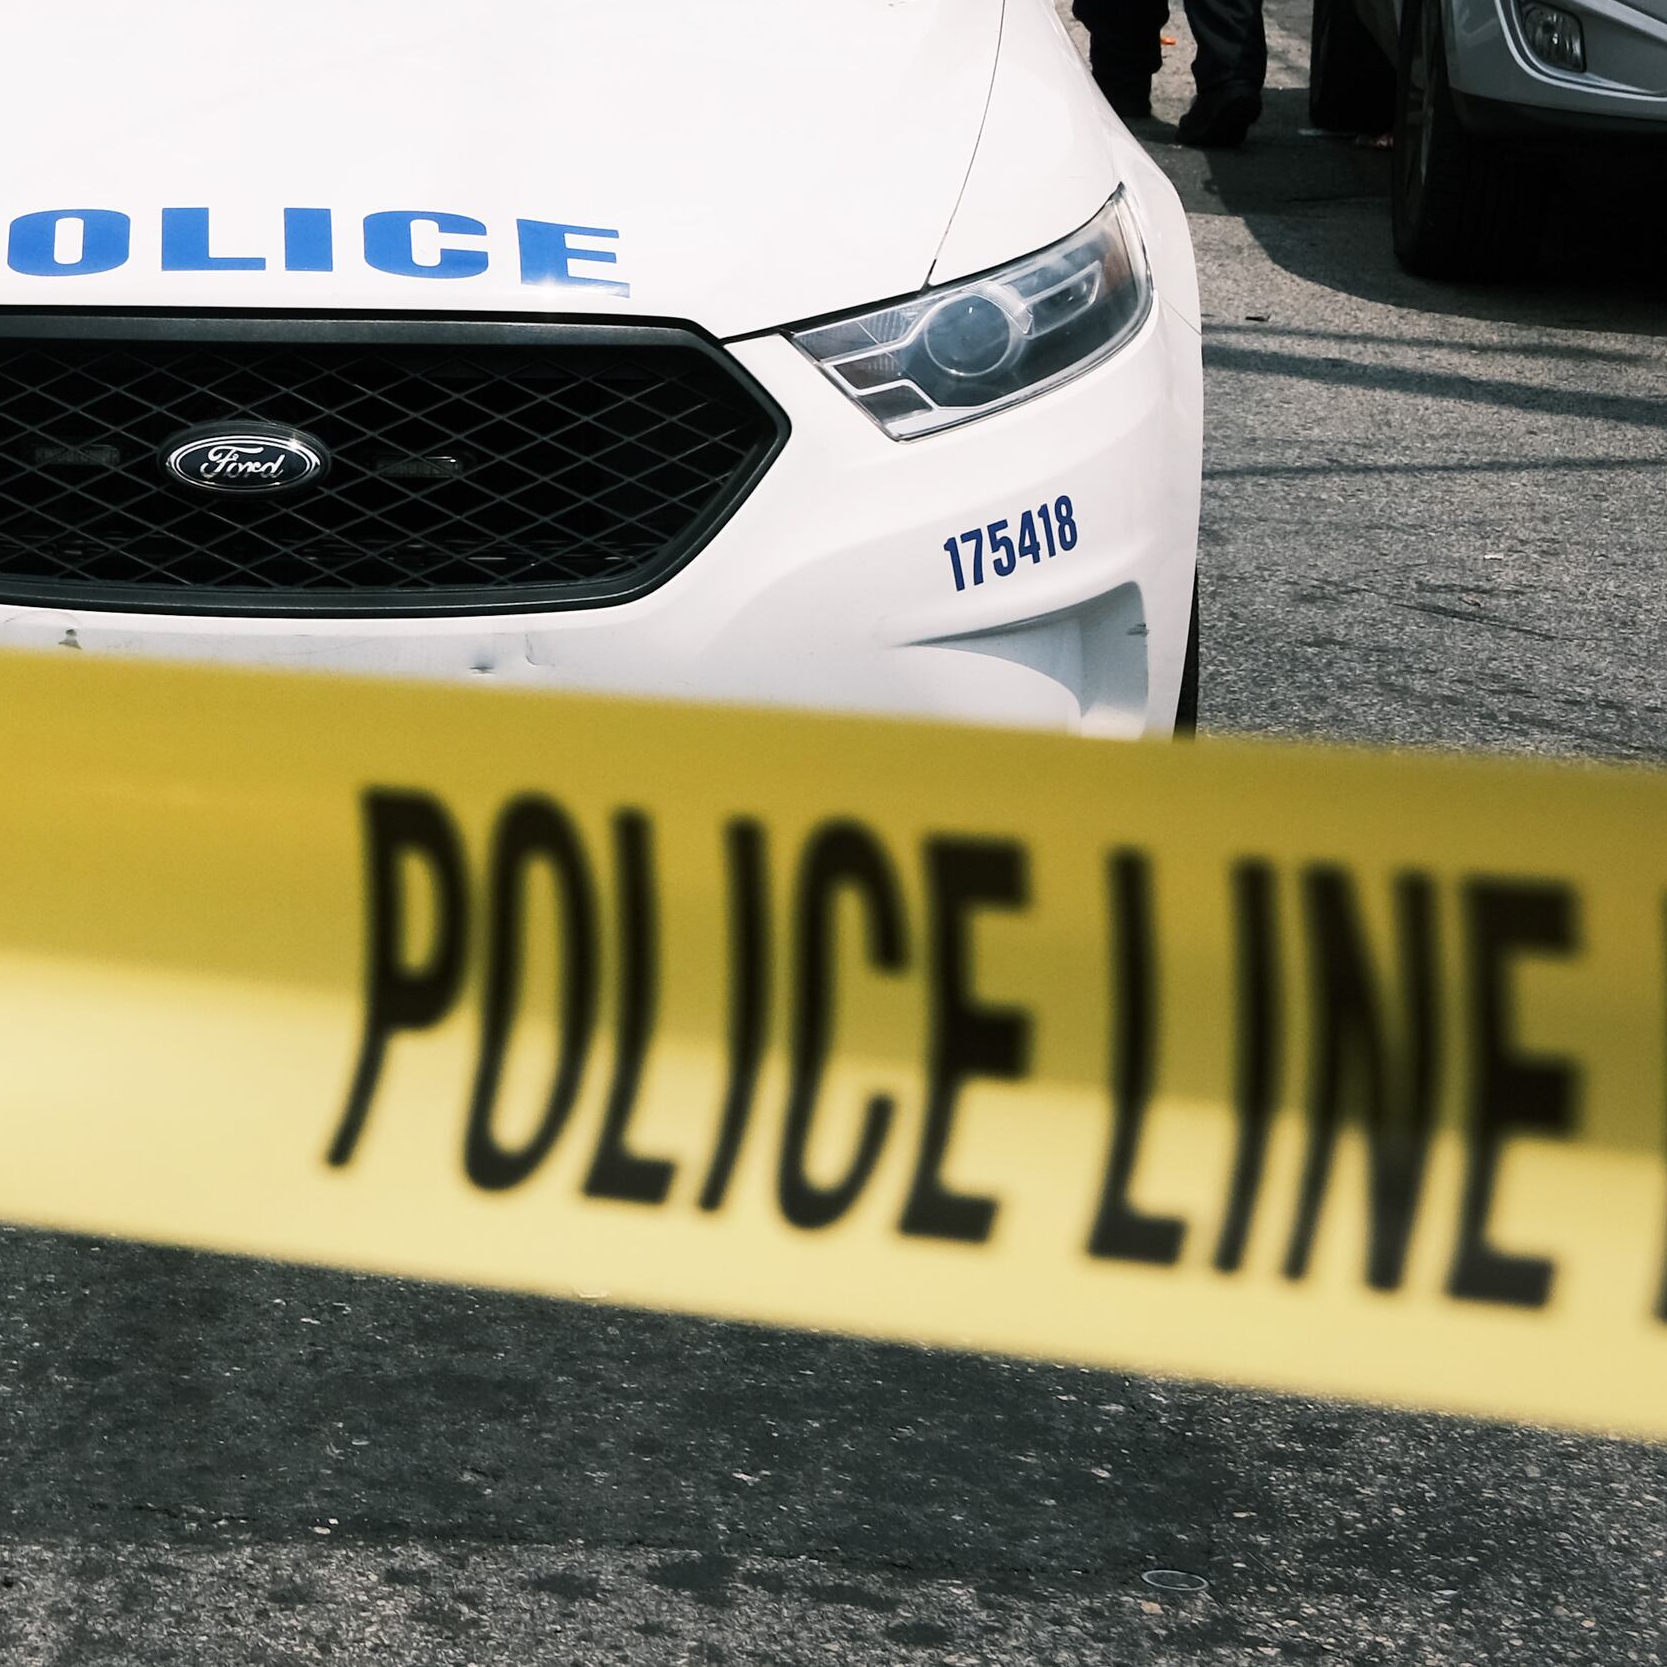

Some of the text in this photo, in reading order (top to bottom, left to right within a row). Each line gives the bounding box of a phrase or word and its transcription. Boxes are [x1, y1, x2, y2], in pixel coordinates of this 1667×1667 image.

[200, 445, 286, 479] Ford
[943, 495, 1078, 592] 175418
[324, 784, 1035, 1247] POLICE
[1085, 843, 1585, 1316] LINE
